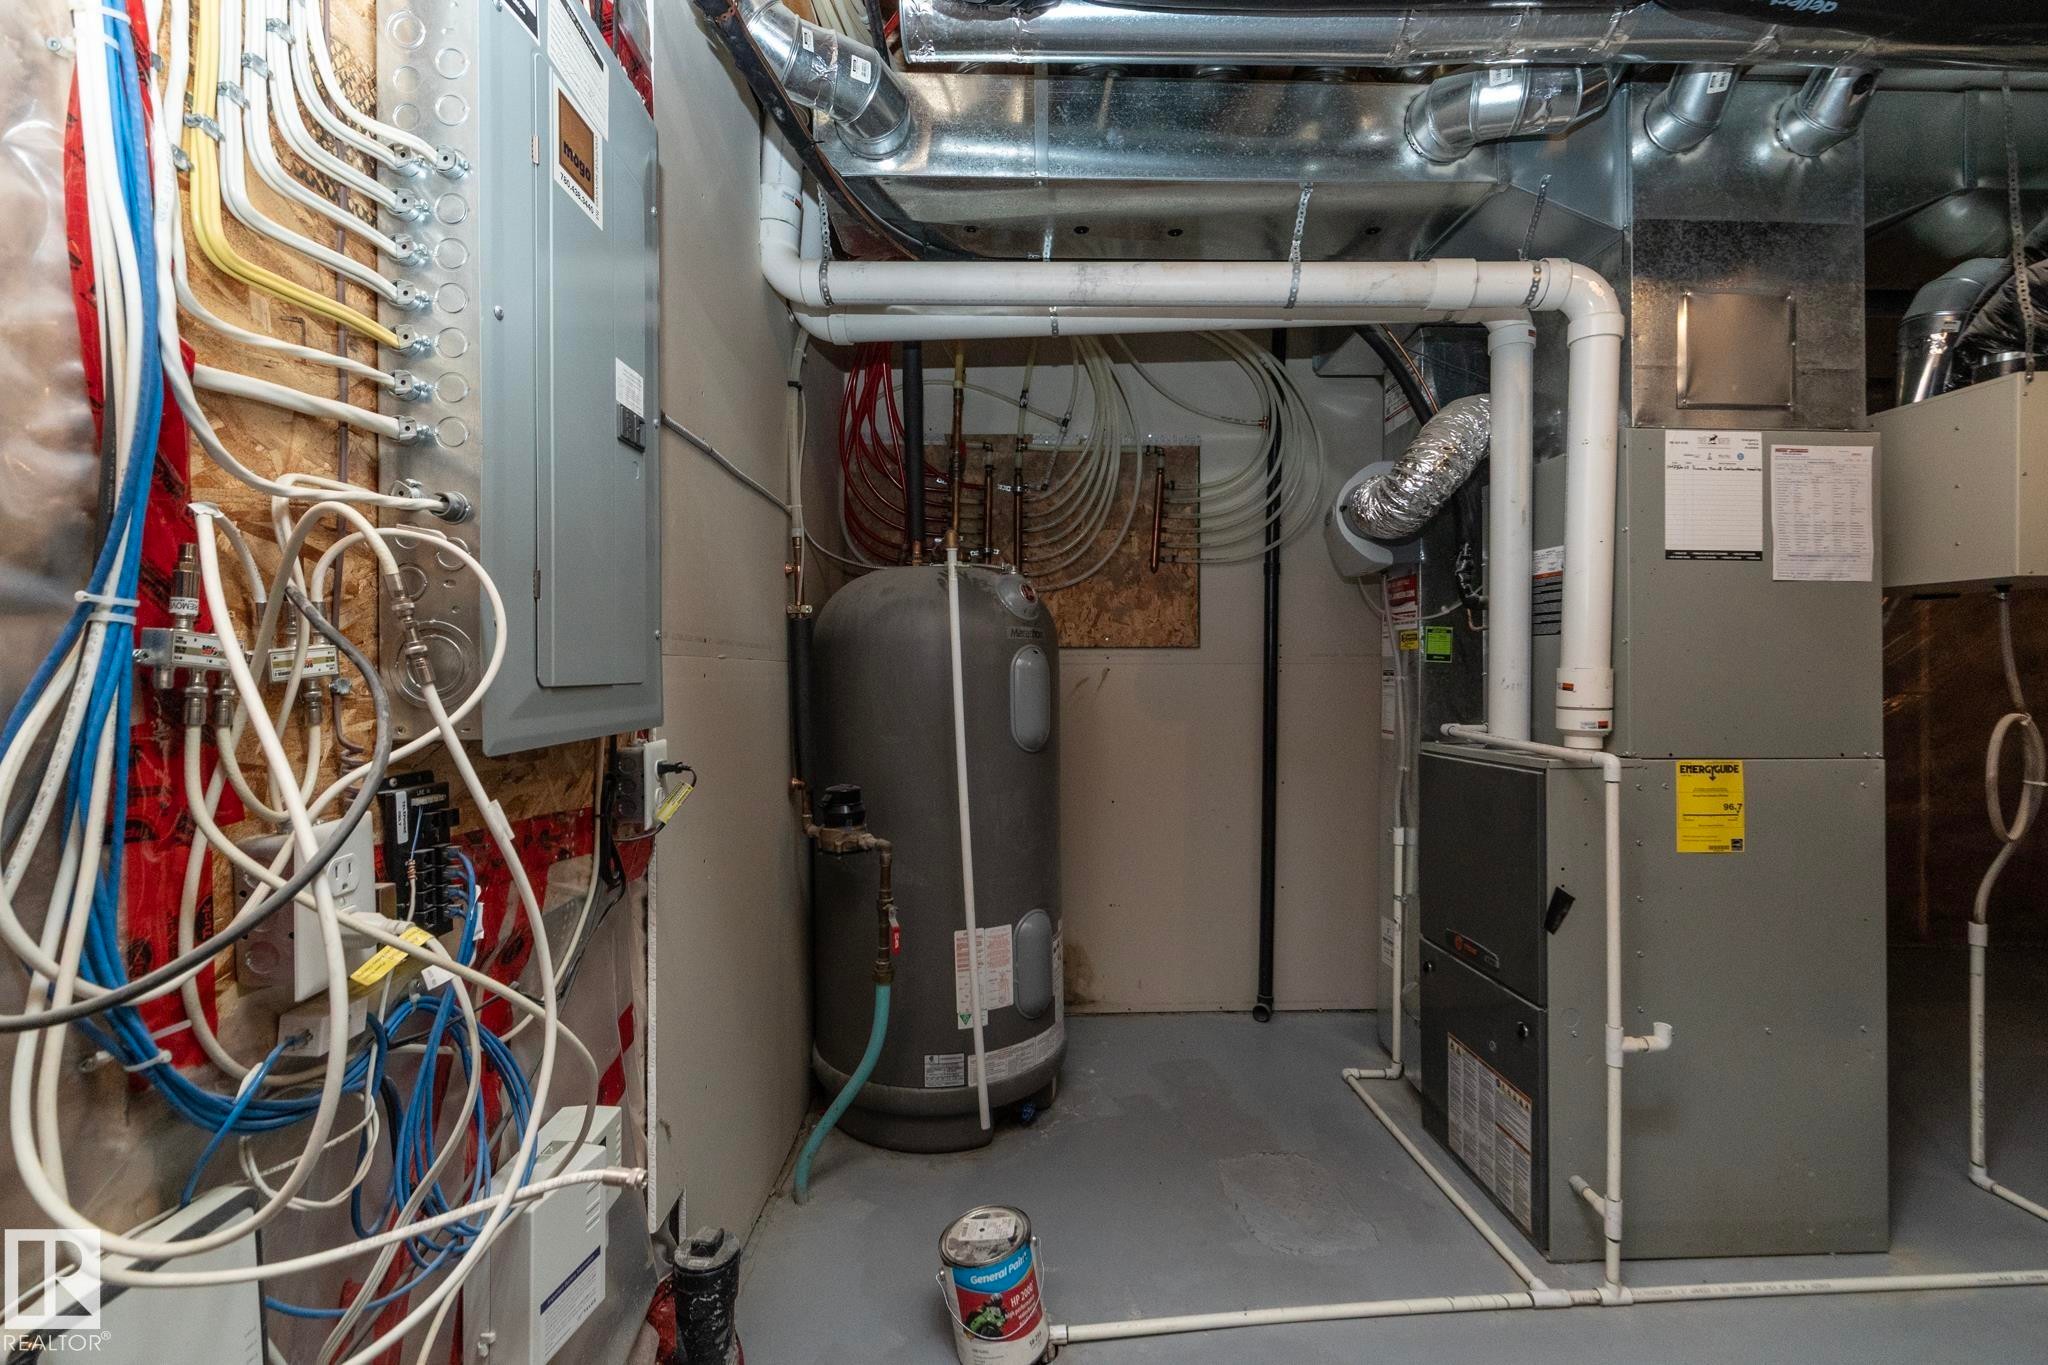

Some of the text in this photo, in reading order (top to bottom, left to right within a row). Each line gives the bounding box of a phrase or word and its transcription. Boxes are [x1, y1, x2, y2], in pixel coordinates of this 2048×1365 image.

[563, 141, 591, 181] mogo
[1723, 803, 1742, 811] 96.7
[970, 1269, 1007, 1285] General
[1010, 1294, 1020, 1307] HP
